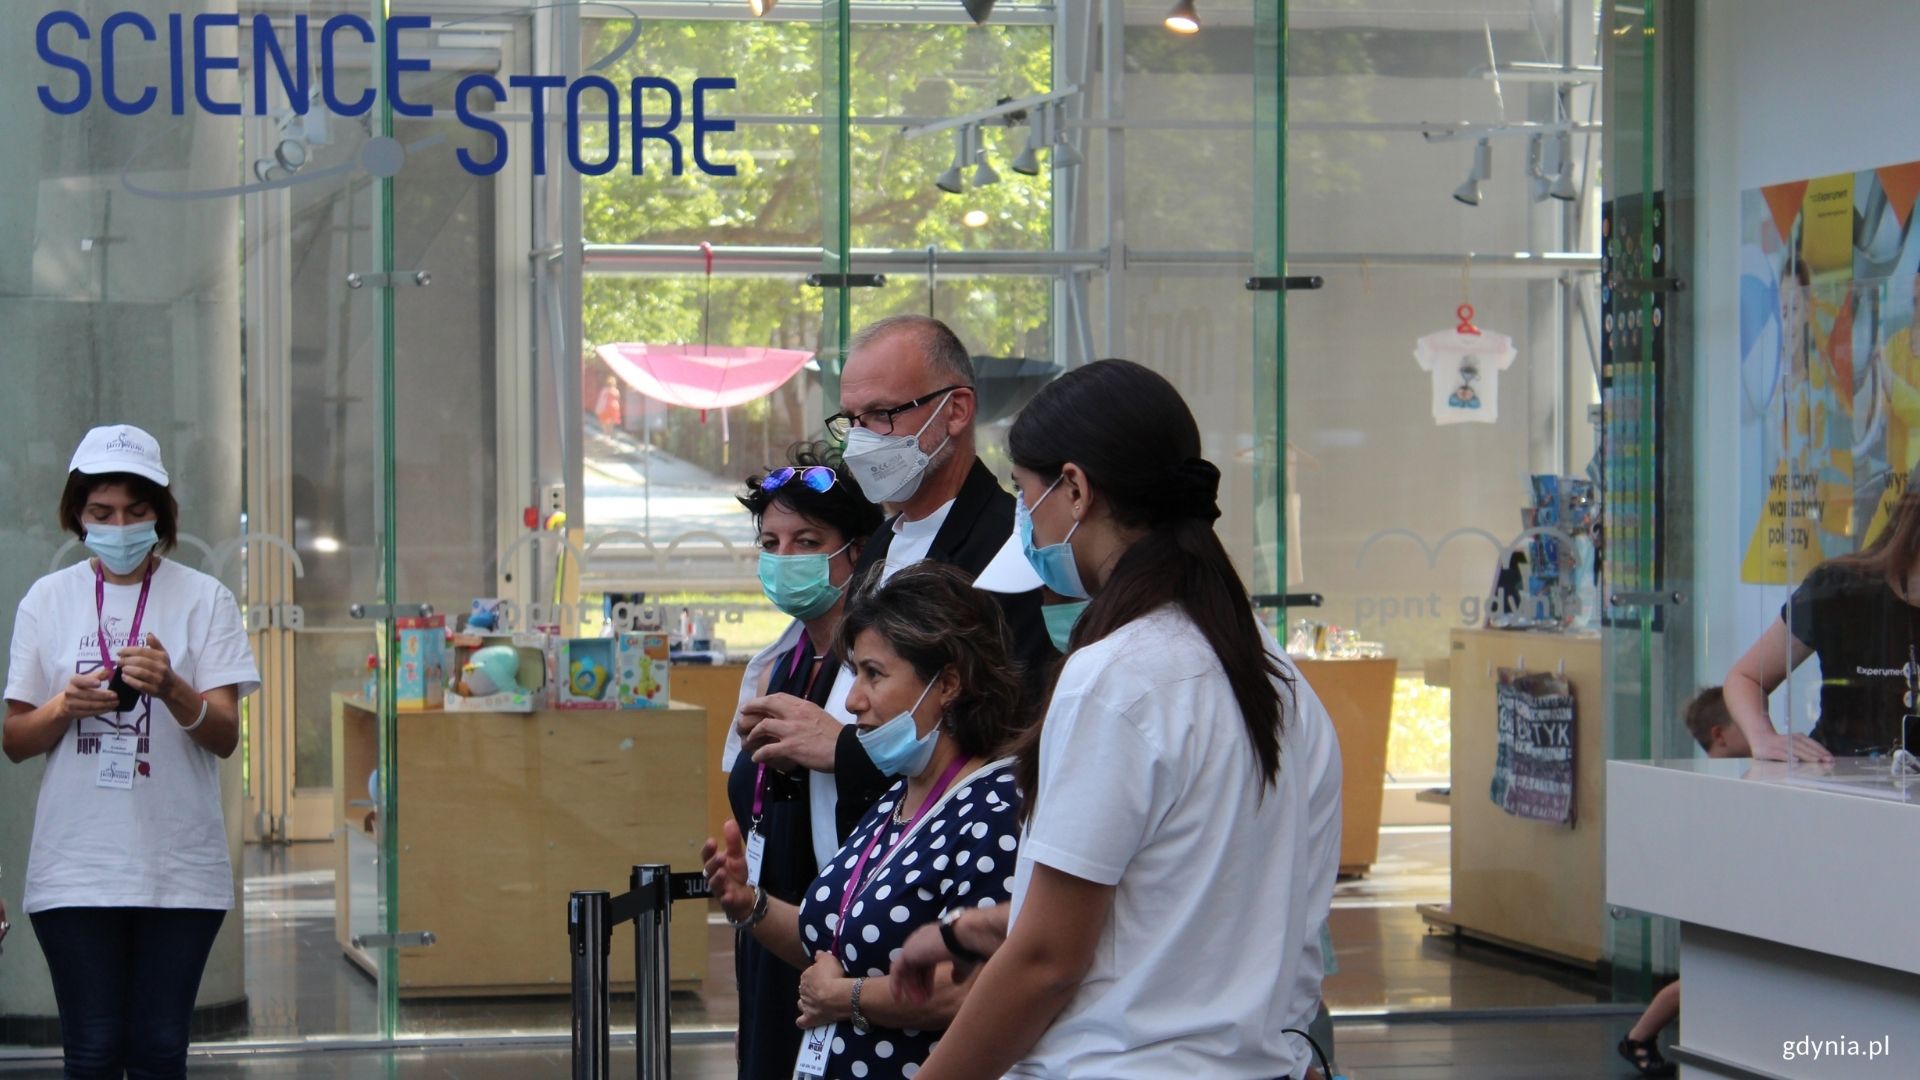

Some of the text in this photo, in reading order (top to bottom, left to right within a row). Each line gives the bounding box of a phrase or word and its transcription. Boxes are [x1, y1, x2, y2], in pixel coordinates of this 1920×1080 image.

[36, 11, 433, 117] SCIENCE
[455, 74, 738, 176] STORE
[1356, 593, 1441, 624] ppnt
